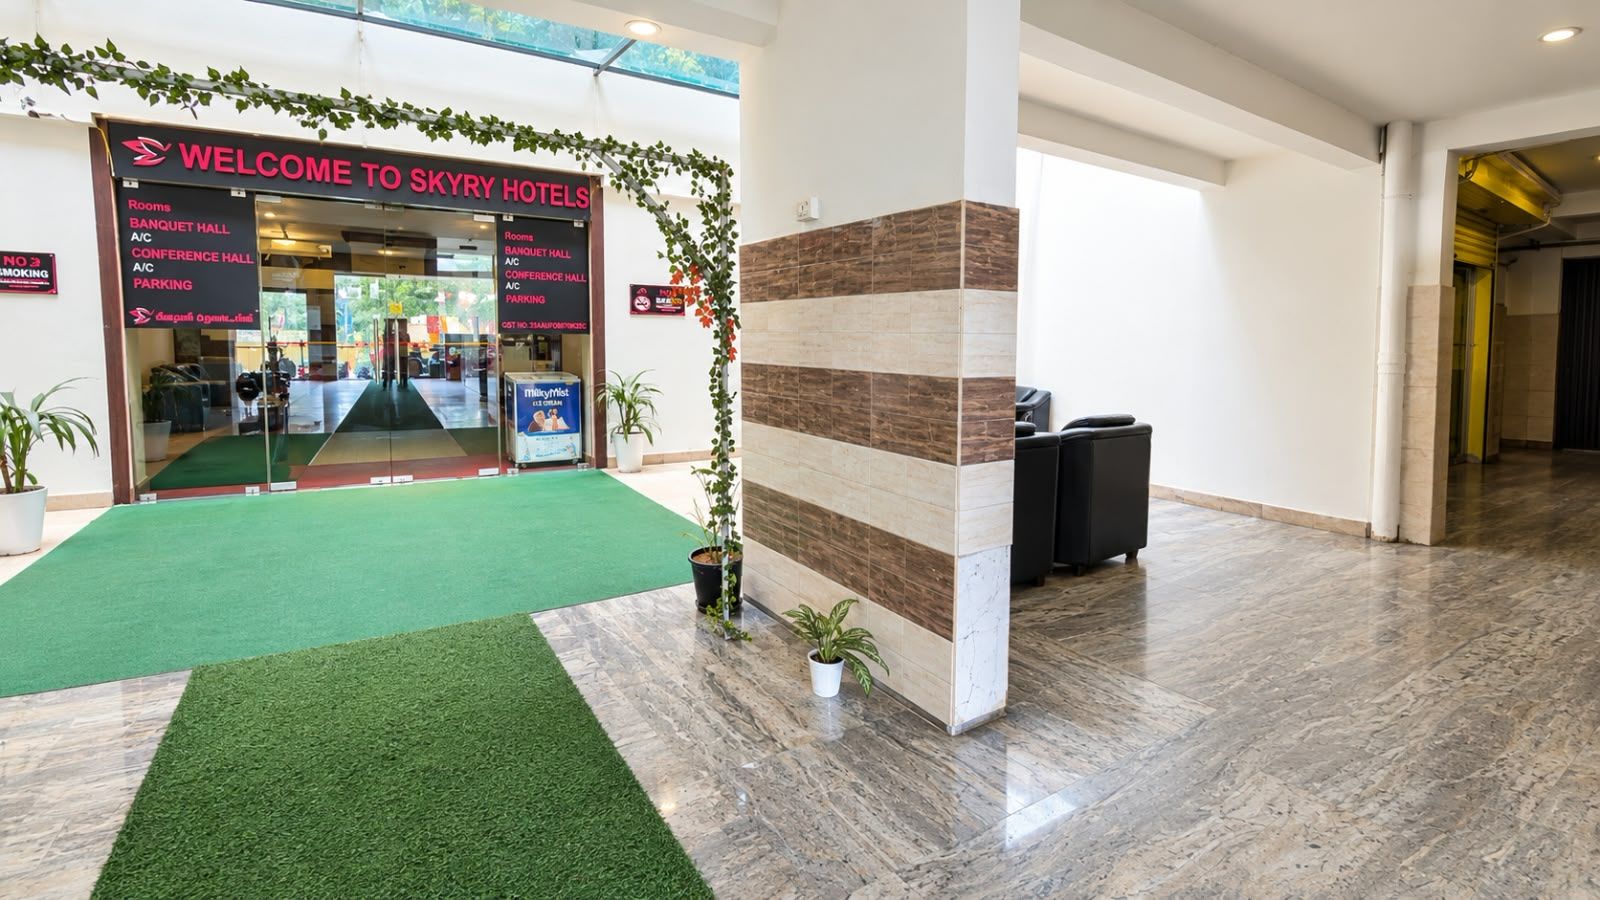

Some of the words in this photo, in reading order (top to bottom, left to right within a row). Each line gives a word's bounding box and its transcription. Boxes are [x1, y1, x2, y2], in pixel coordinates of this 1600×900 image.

[179, 142, 353, 186] WELCOME
[361, 162, 402, 191] TO
[410, 168, 495, 200] SKYRY
[502, 178, 590, 209] HOTELS
[128, 199, 171, 212] Rooms
[129, 217, 193, 232] BANQUET
[197, 222, 230, 235] HALL
[130, 232, 152, 243] A/C
[504, 231, 534, 242] Rooms
[131, 247, 218, 263] CONFERENCE
[222, 253, 254, 265] HALL
[504, 246, 548, 257] BANQUET
[549, 249, 571, 259] HALL
[3, 255, 27, 268] NO
[132, 262, 154, 273] A/C
[505, 257, 520, 266] A/C
[505, 270, 563, 281] CONFERENCE
[565, 274, 587, 283] HALL
[133, 277, 193, 291] PARKING
[505, 281, 520, 290] A/C
[506, 295, 546, 304] PARKING
[502, 321, 515, 329] GST
[524, 387, 570, 399] MilkyMist
